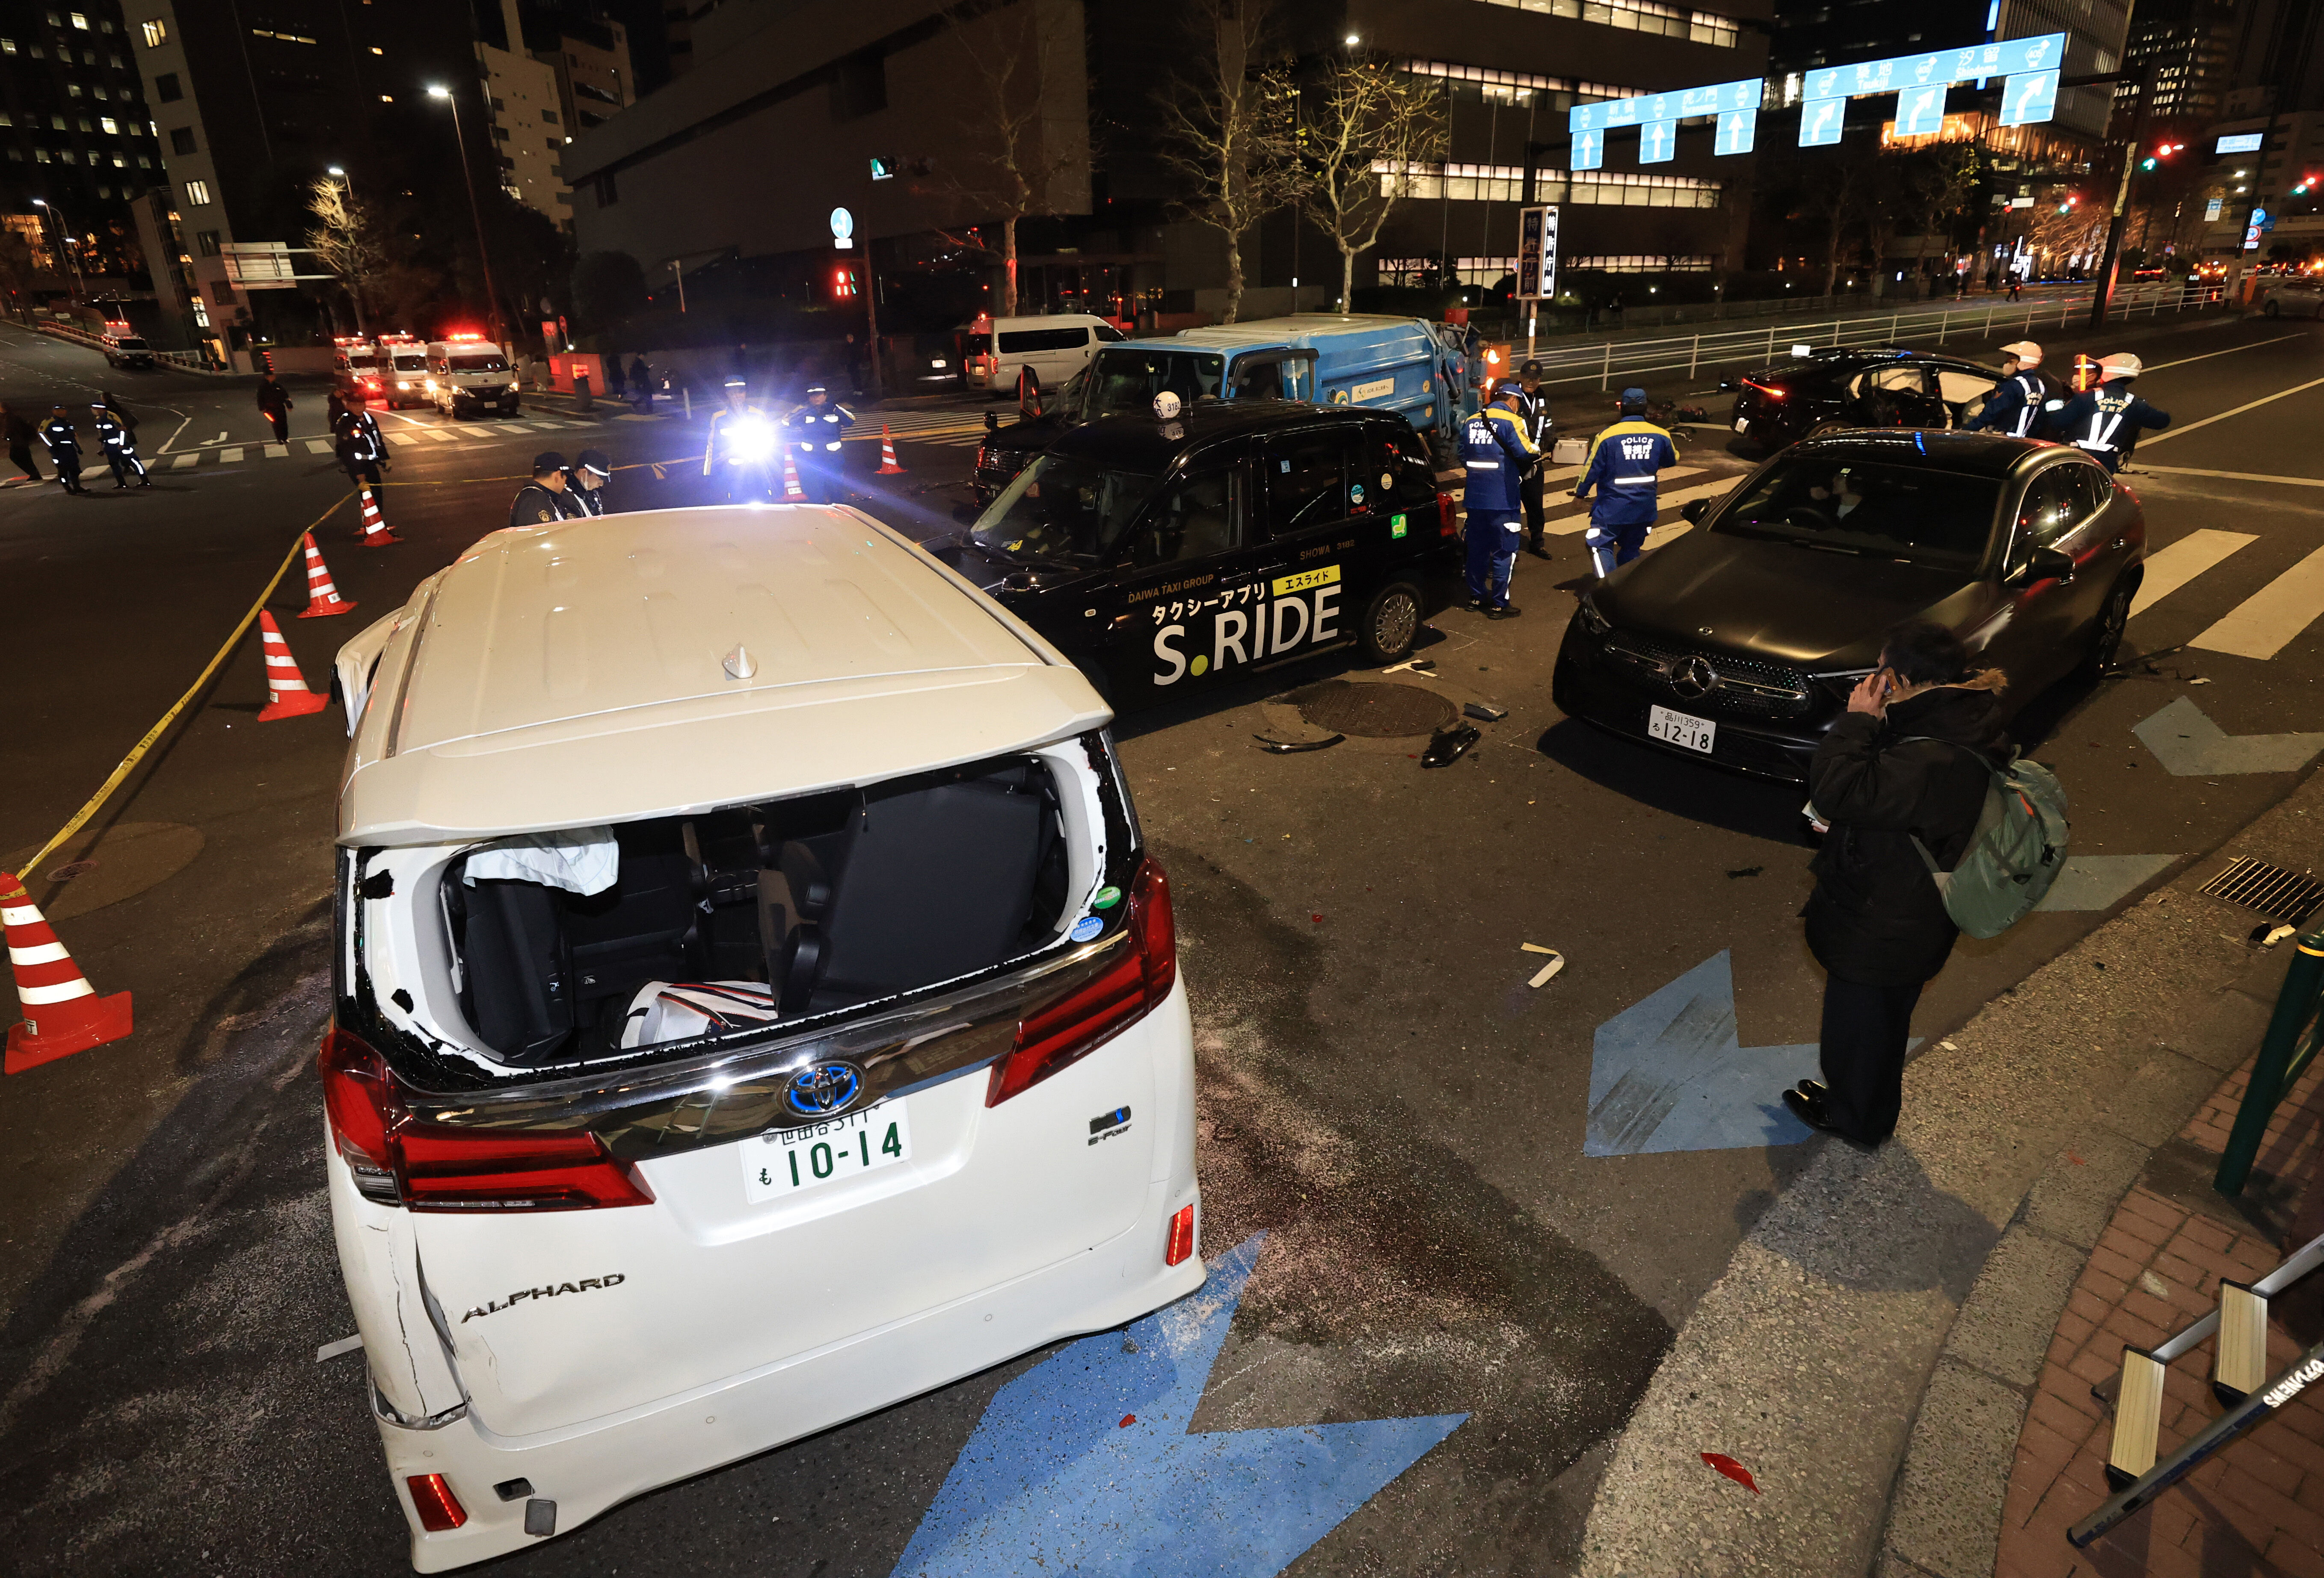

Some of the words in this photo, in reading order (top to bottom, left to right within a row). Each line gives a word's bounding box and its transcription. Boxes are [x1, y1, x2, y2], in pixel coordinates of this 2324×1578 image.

[1958, 46, 2000, 66] 汐留
[2028, 50, 2042, 58] 405
[1856, 62, 1893, 79] 築地
[1956, 65, 1998, 78] Shiodome
[1858, 77, 1889, 90] Tsukiji
[1682, 88, 1717, 105] 虎ノ門
[1524, 216, 1539, 291] 特許庁前
[1544, 215, 1556, 291] 特許庁前
[1167, 401, 1180, 412] 3182
[2097, 397, 2129, 409] POLICE
[1469, 421, 1498, 433] POLCE
[1621, 436, 1654, 445] POLICE
[1299, 545, 1331, 561] SHOWA
[1337, 539, 1355, 550] 3182
[1128, 587, 1160, 604] DAIWA
[1161, 582, 1181, 595] TAXI
[1183, 574, 1214, 590] GROUP
[1285, 570, 1329, 590] エスライド
[1152, 582, 1265, 626] タクシーアプリ
[1154, 584, 1341, 685] S.RIDE
[1664, 722, 1709, 750] 12-18
[759, 1168, 772, 1186] も
[788, 1121, 902, 1187] 10-14
[460, 1273, 625, 1324] ALPHARD
